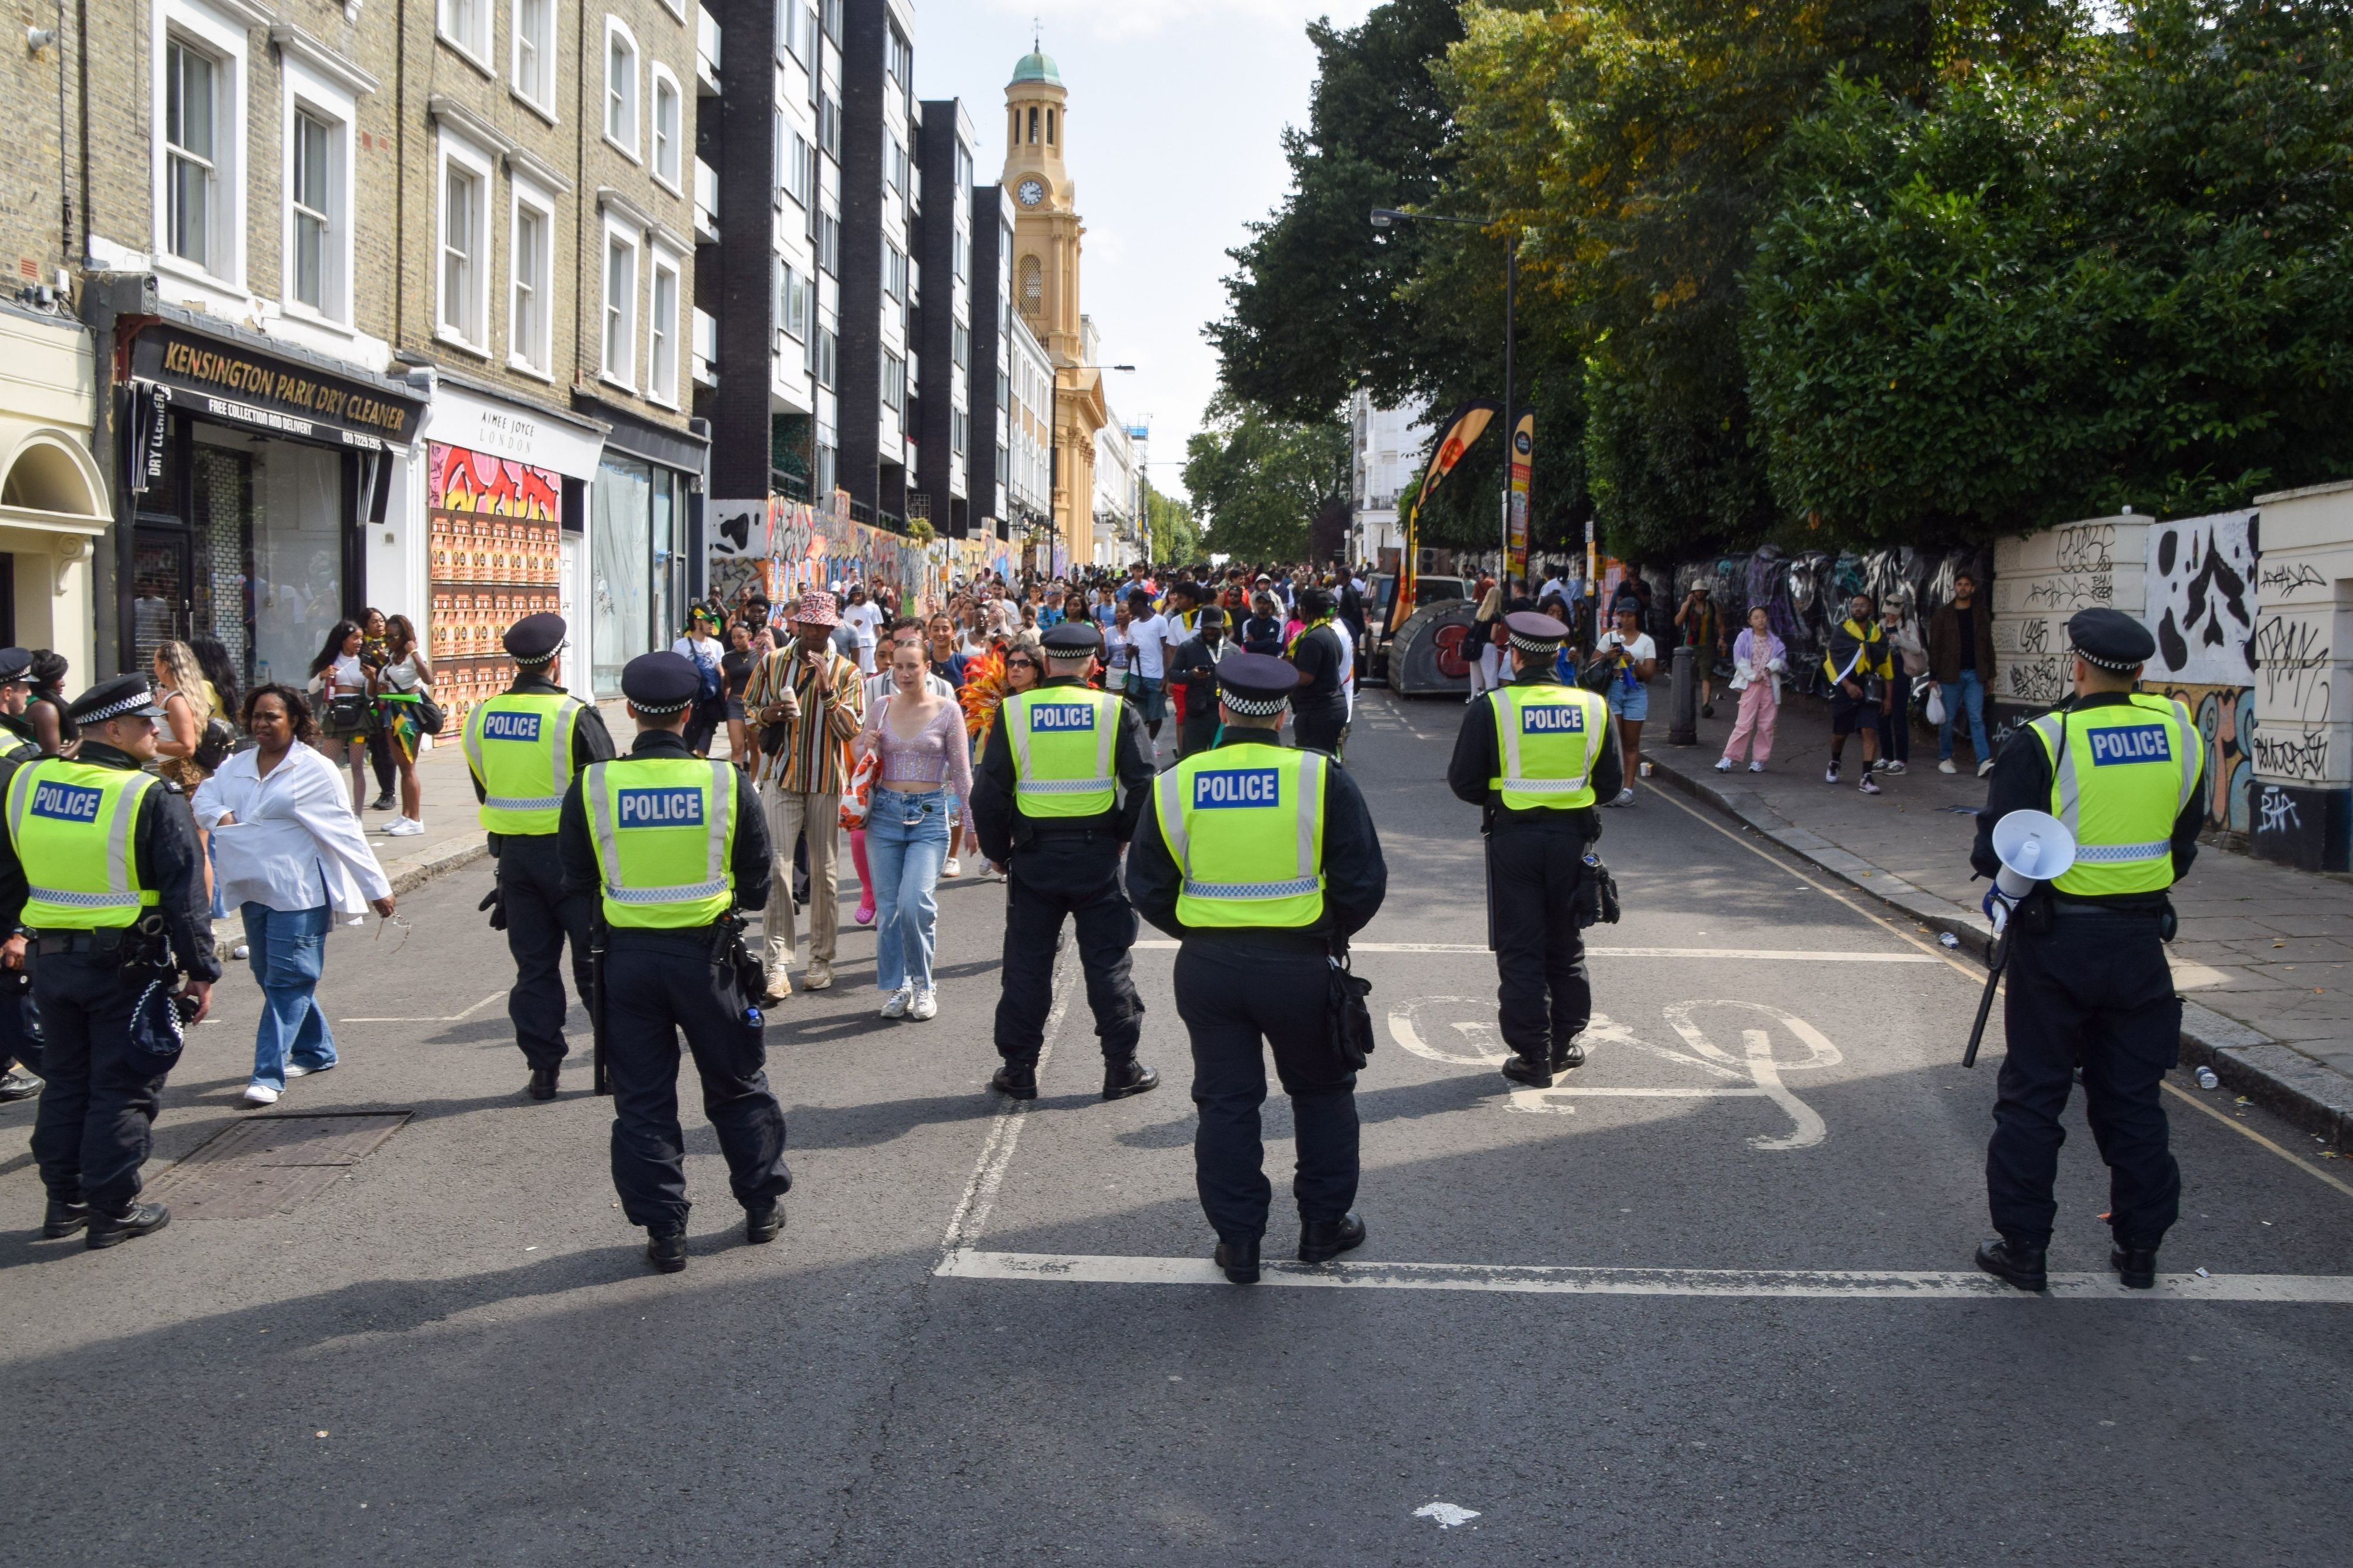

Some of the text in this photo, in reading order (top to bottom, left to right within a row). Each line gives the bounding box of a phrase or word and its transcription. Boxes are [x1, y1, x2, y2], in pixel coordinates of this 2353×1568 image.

[165, 341, 405, 431] KENSINGTON PARK DRY CLEANER
[209, 399, 312, 435] FREE COLLECTION AND DELIVERY
[481, 412, 534, 436] AIMEE JOYCE
[342, 431, 354, 444] 020
[354, 433, 368, 447] 7229
[480, 428, 531, 453] LONDON
[148, 450, 162, 476] DRY
[485, 715, 537, 738] POLICE
[1032, 706, 1091, 728] POLICE
[1524, 709, 1582, 729] POLICE
[2092, 730, 2168, 759] POLICE
[34, 786, 98, 817] POLICE
[1197, 775, 1275, 802] POLICE
[622, 793, 699, 820] POLICE
